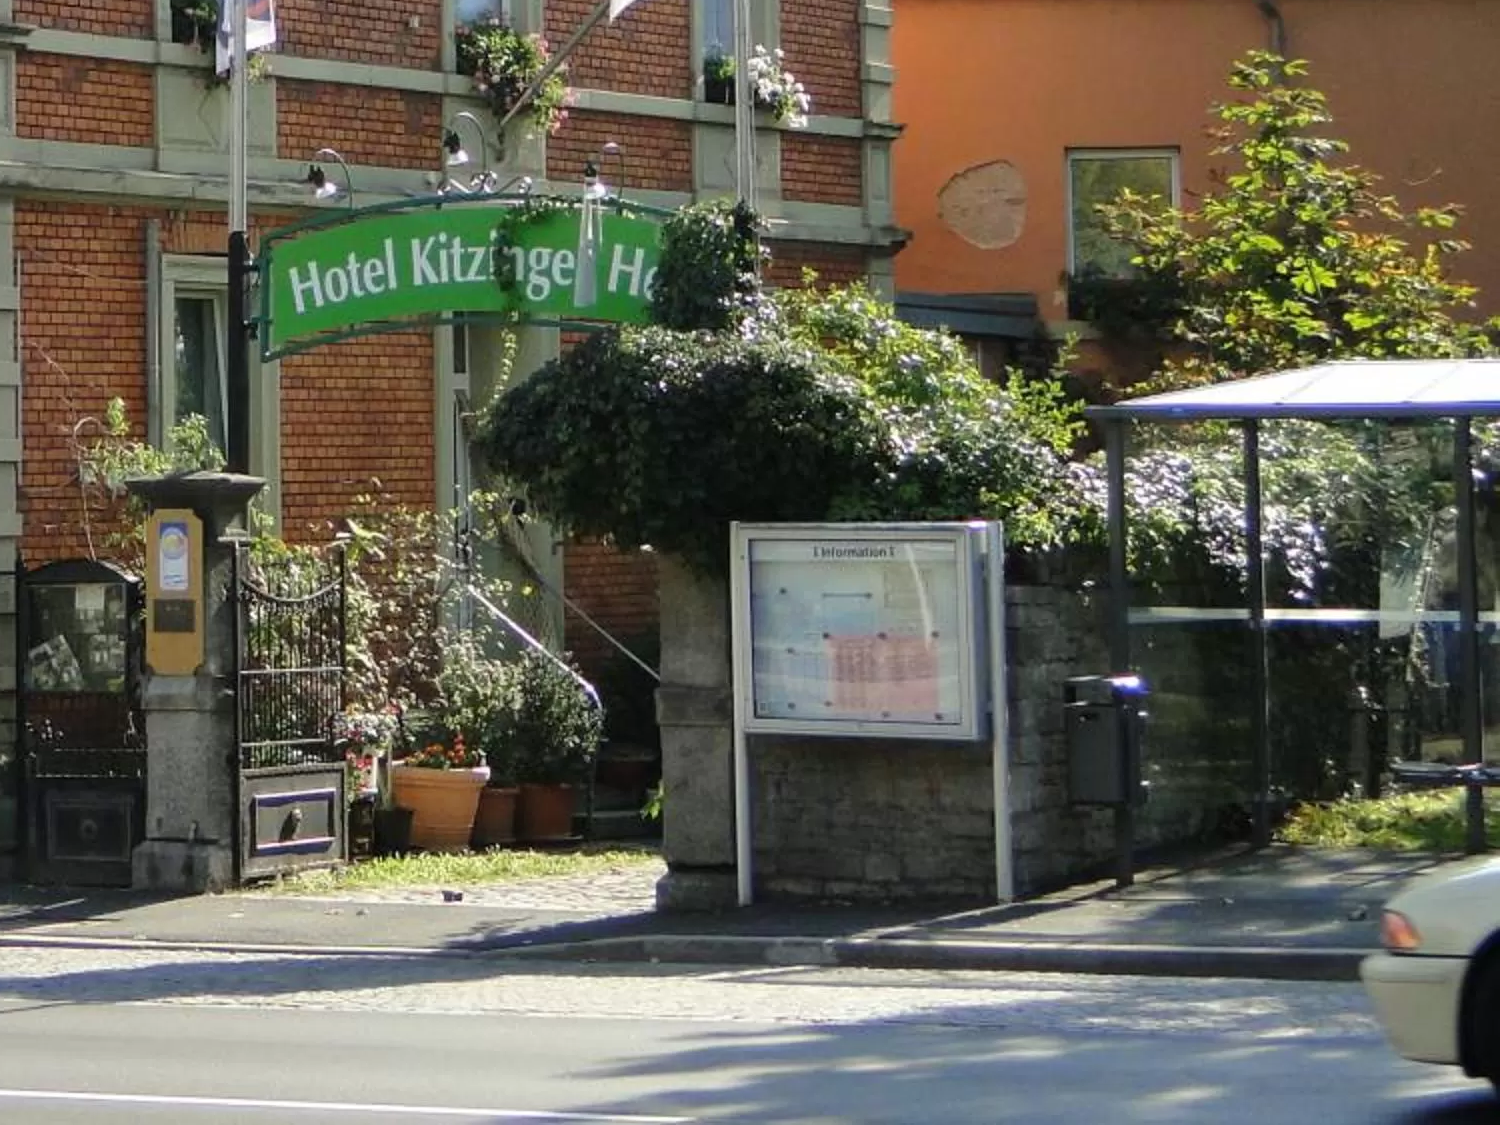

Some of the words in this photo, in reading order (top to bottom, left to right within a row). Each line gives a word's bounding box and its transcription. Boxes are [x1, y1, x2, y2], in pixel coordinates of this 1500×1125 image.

[288, 237, 398, 315] Hotel
[411, 228, 578, 302] Kitzinge
[821, 546, 887, 558] Information
